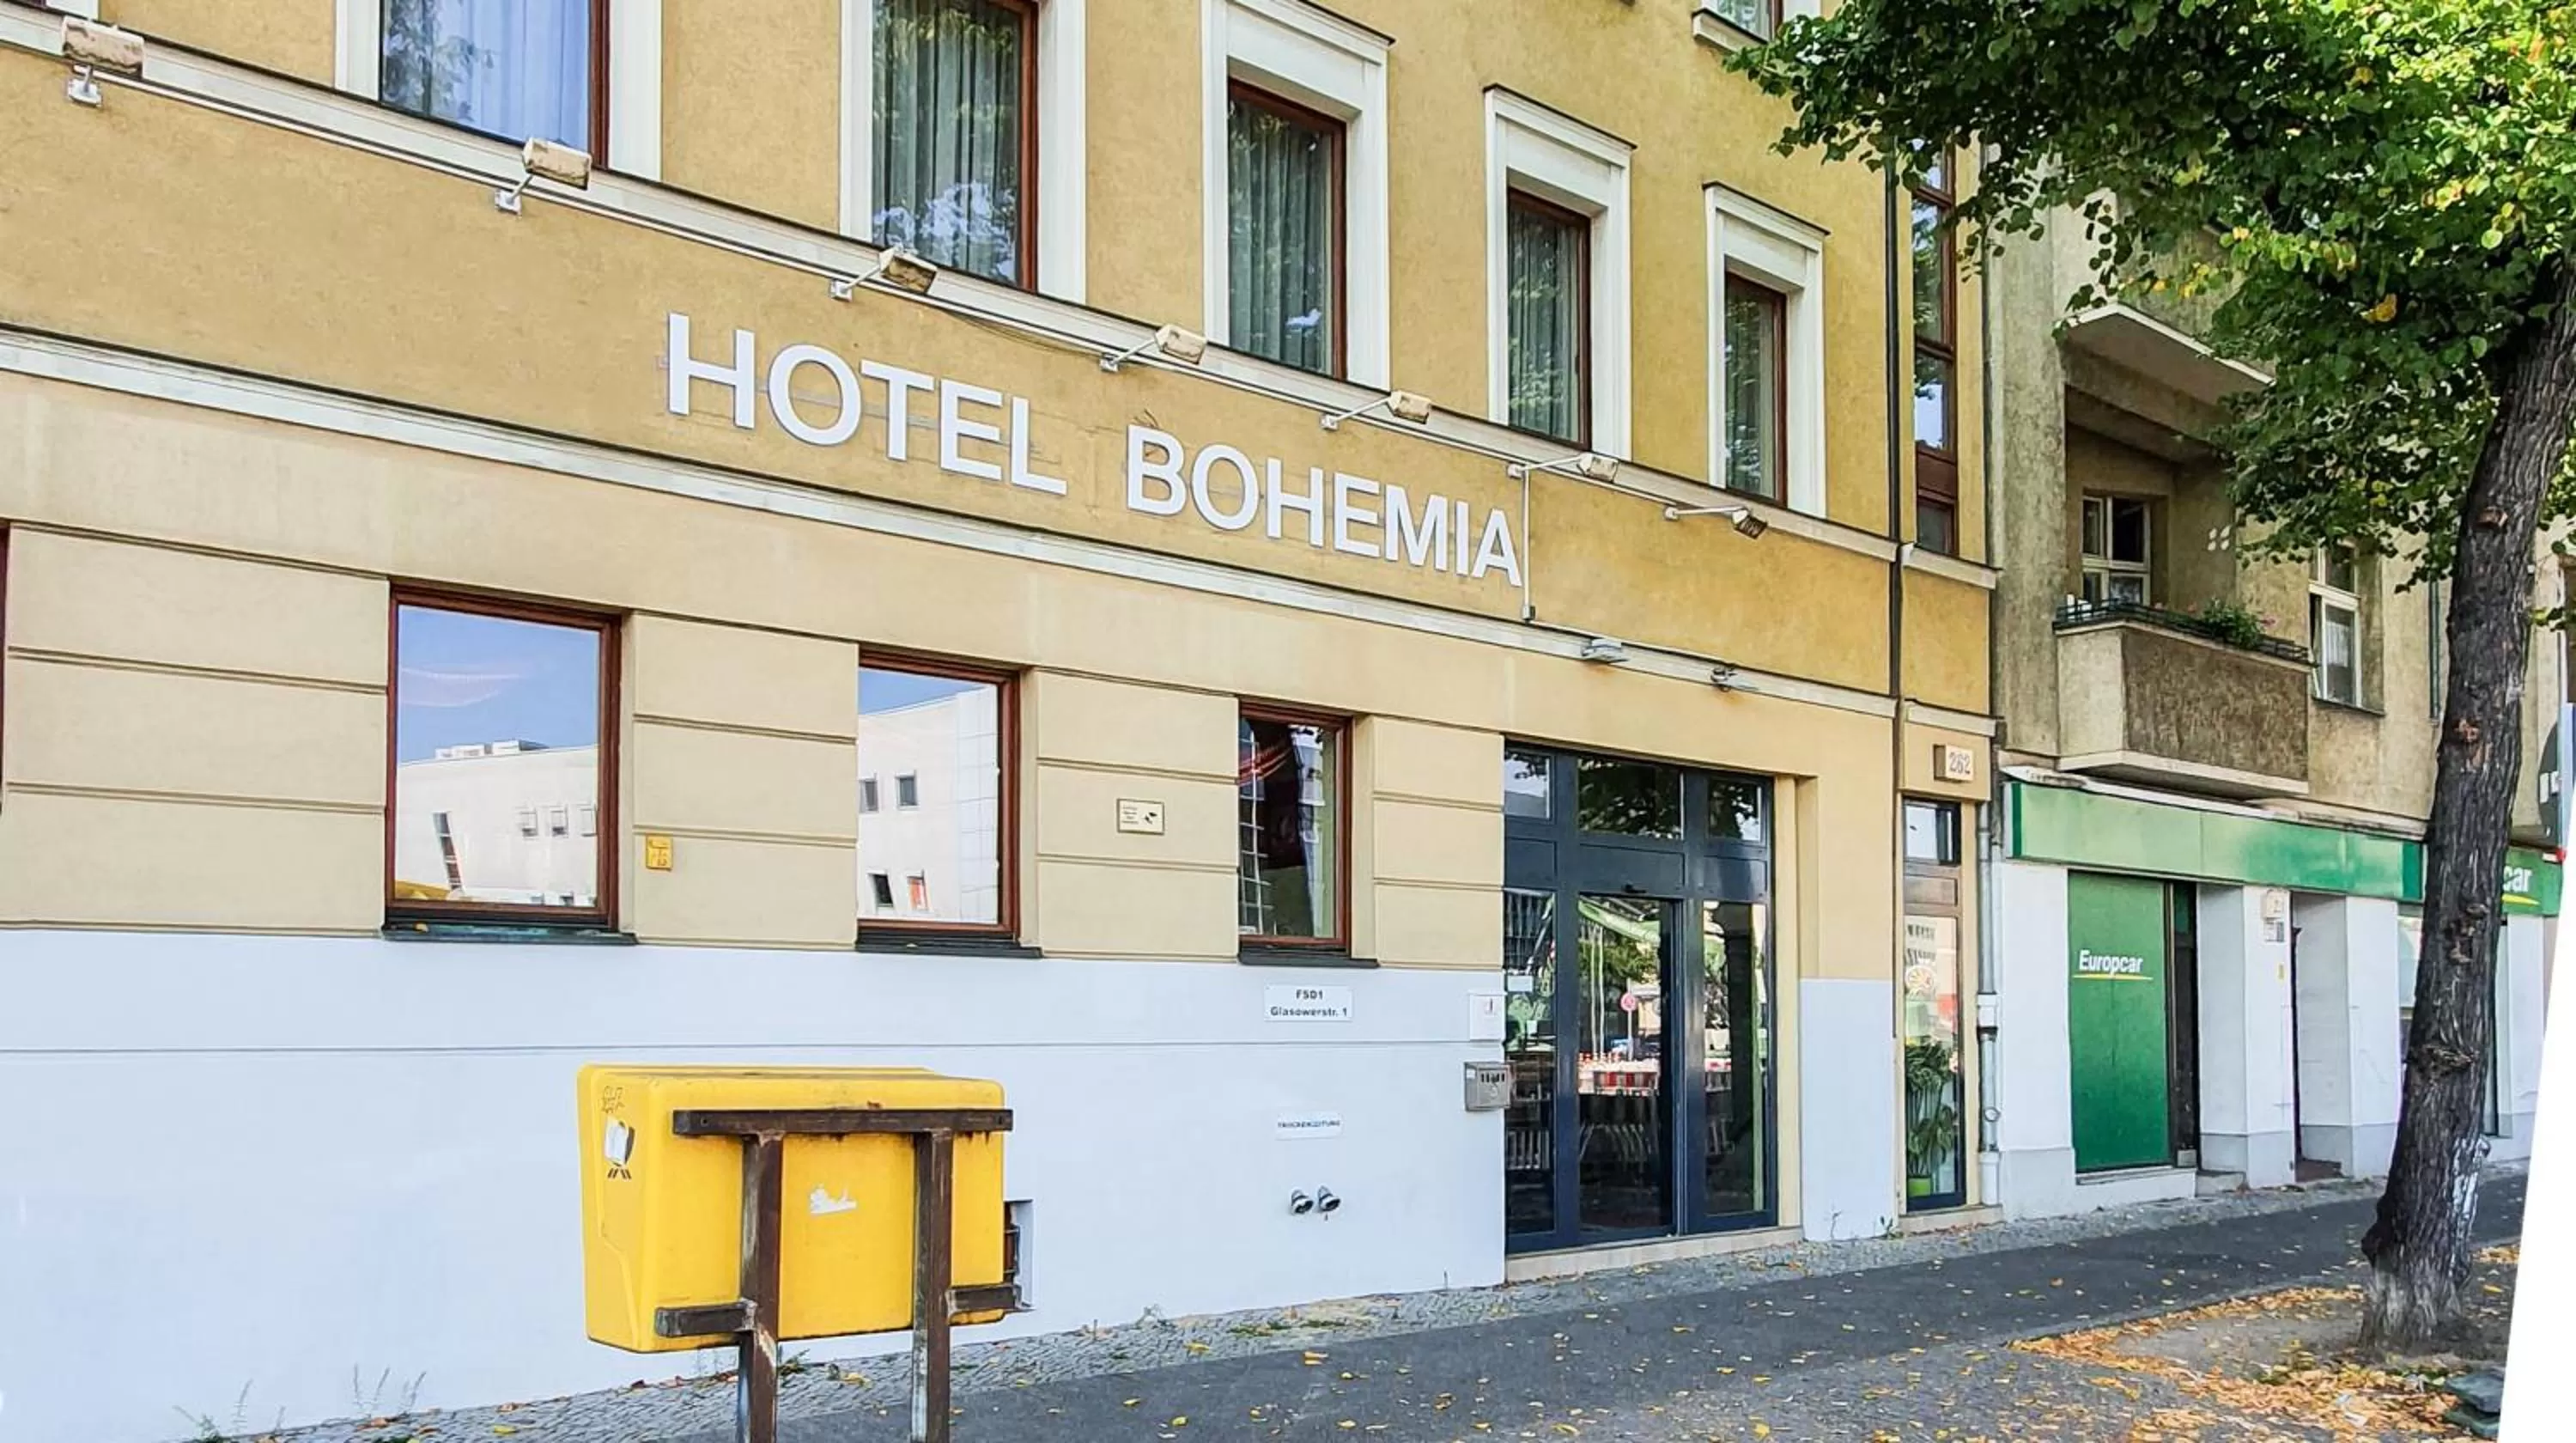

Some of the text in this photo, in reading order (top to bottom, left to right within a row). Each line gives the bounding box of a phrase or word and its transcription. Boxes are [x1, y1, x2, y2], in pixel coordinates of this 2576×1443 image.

[668, 312, 1522, 587] HOTEL BOHEMIA
[2079, 949, 2144, 977] Europcar
[1342, 1007, 1347, 1017] 1
